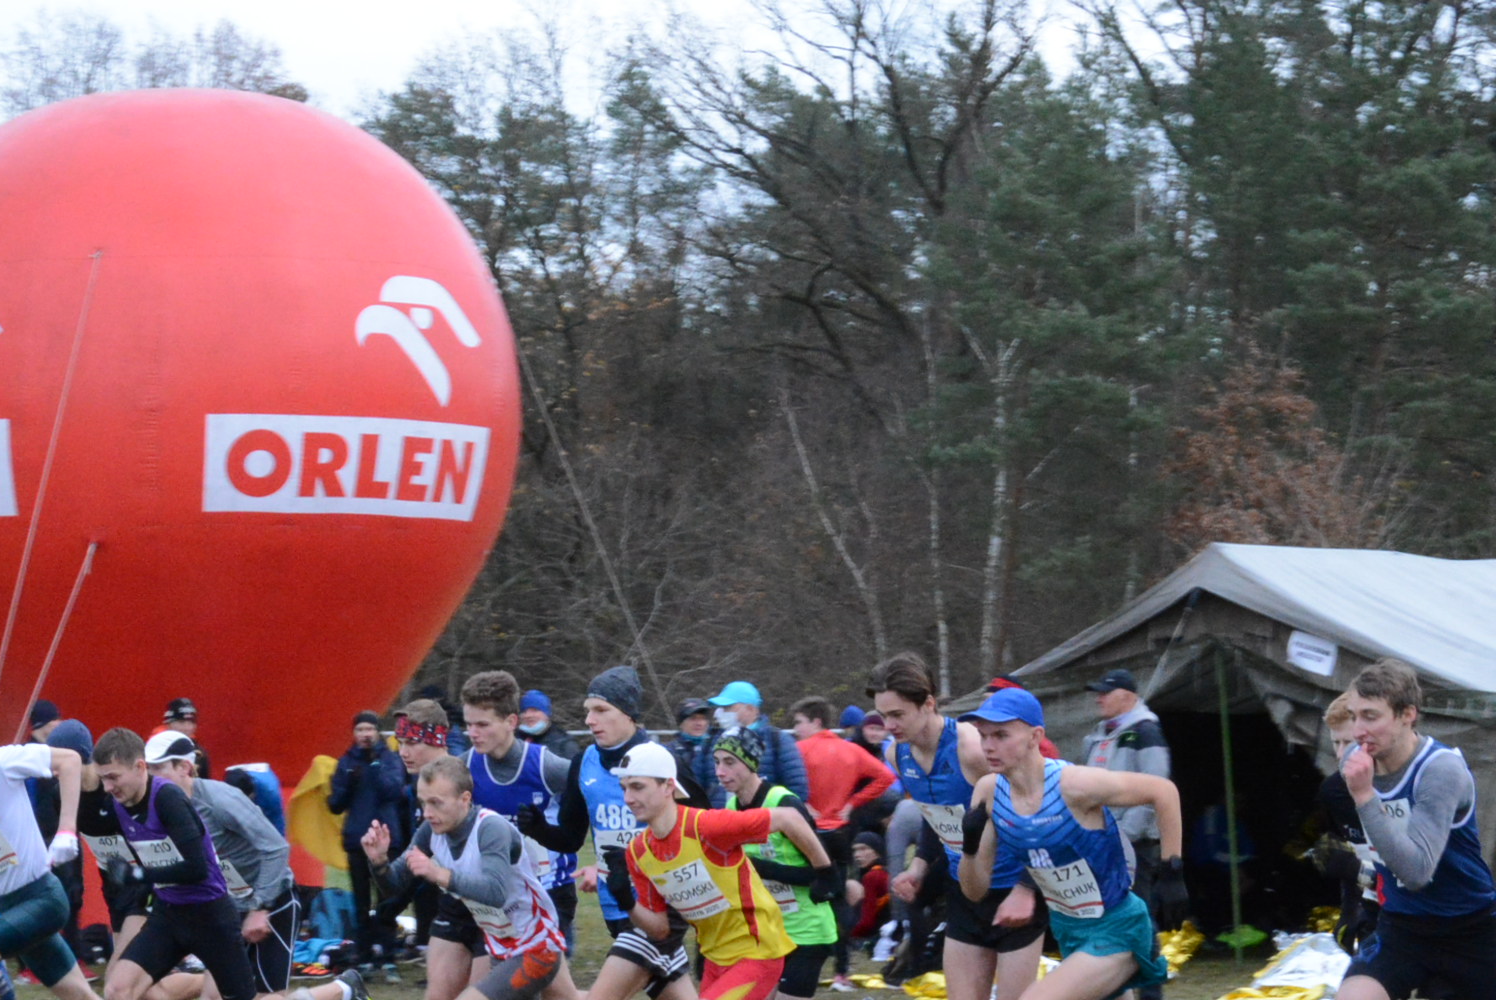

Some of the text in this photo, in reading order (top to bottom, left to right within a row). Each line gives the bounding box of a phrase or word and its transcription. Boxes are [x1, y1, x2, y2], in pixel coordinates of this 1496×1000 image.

[224, 429, 476, 505] ORLEN
[595, 803, 638, 830] 486
[98, 836, 119, 847] 407
[150, 840, 173, 854] 210
[672, 862, 700, 884] 557
[1051, 864, 1085, 883] 171
